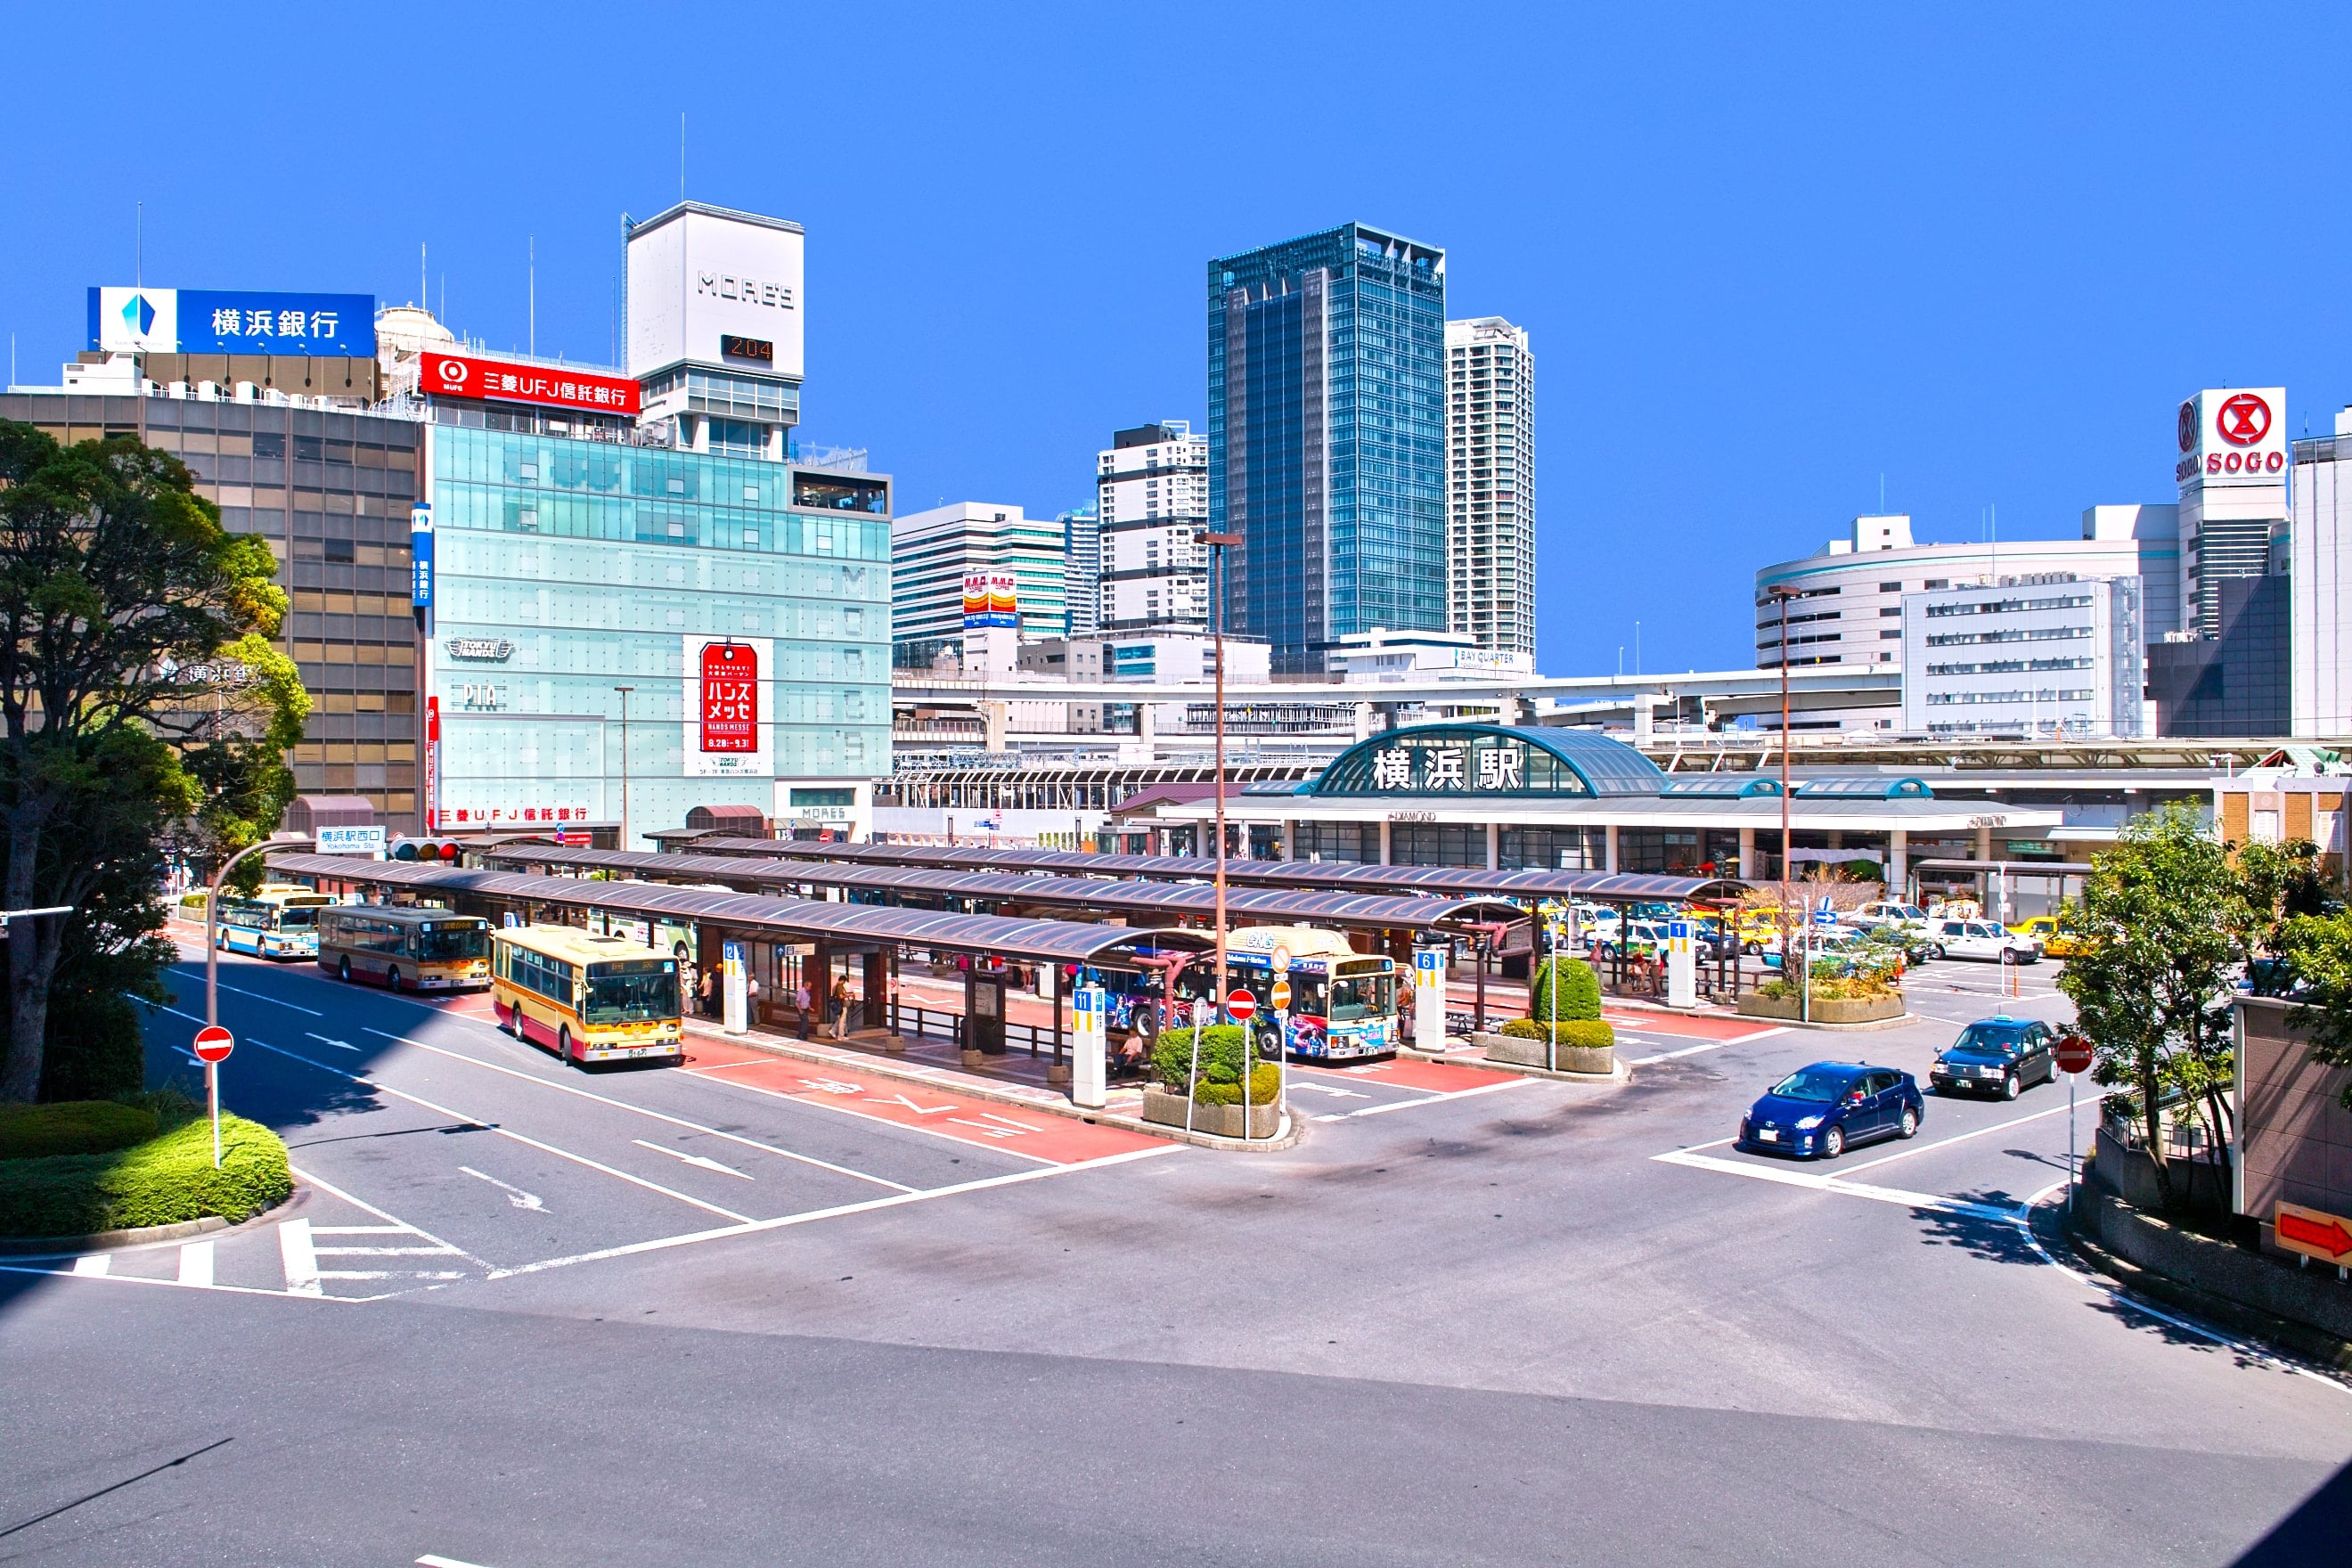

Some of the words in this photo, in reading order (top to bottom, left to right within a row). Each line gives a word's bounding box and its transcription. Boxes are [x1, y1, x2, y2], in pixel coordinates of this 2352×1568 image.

[698, 269, 794, 310] MORE'S
[211, 308, 339, 338] 横浜銀行
[443, 383, 463, 392] MUFG
[484, 372, 626, 406] 三菱UFJ信託銀行
[2176, 454, 2201, 482] SOGO
[2206, 451, 2283, 475] SOGO
[463, 641, 496, 649] TOKYU
[461, 649, 495, 657] HANDS
[1460, 650, 1476, 661] BAY
[1477, 652, 1514, 664] QUARTER
[463, 683, 497, 706] PIA
[707, 682, 751, 700] ハンズ
[707, 701, 750, 720] メッセ
[729, 723, 749, 731] MESSE
[1373, 747, 1522, 790] 横浜駅
[439, 807, 587, 821] 三菱UFJ信託銀行
[803, 807, 845, 819] MORE'S
[1394, 812, 1436, 821] DIAMOND
[322, 830, 380, 842] 横浜駅西口
[1676, 924, 1680, 936] 1
[726, 946, 733, 959] 12
[1423, 955, 1430, 968] 6
[1078, 993, 1087, 1009] 11
